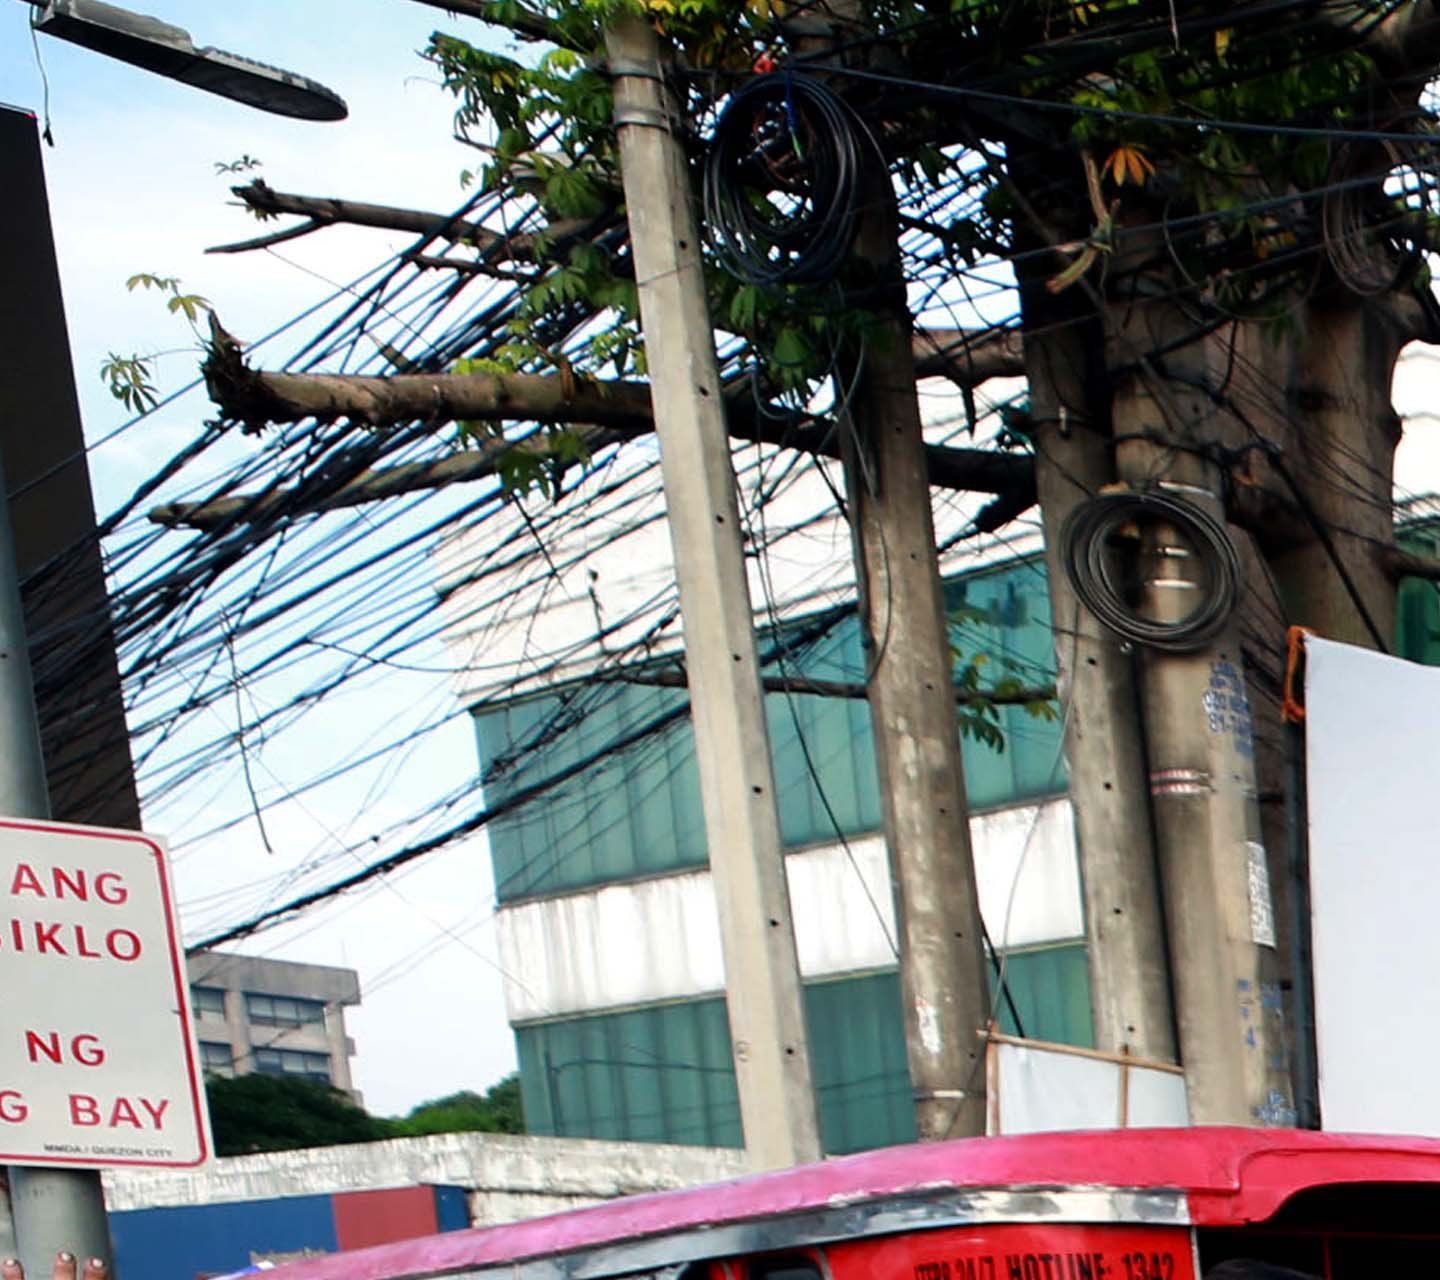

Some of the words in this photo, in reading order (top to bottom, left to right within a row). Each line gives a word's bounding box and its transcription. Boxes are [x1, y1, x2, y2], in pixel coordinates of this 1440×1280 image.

[11, 864, 129, 906] ANG
[0, 919, 142, 962] IKLO
[25, 1030, 106, 1067] NG
[69, 1093, 169, 1131] BAY
